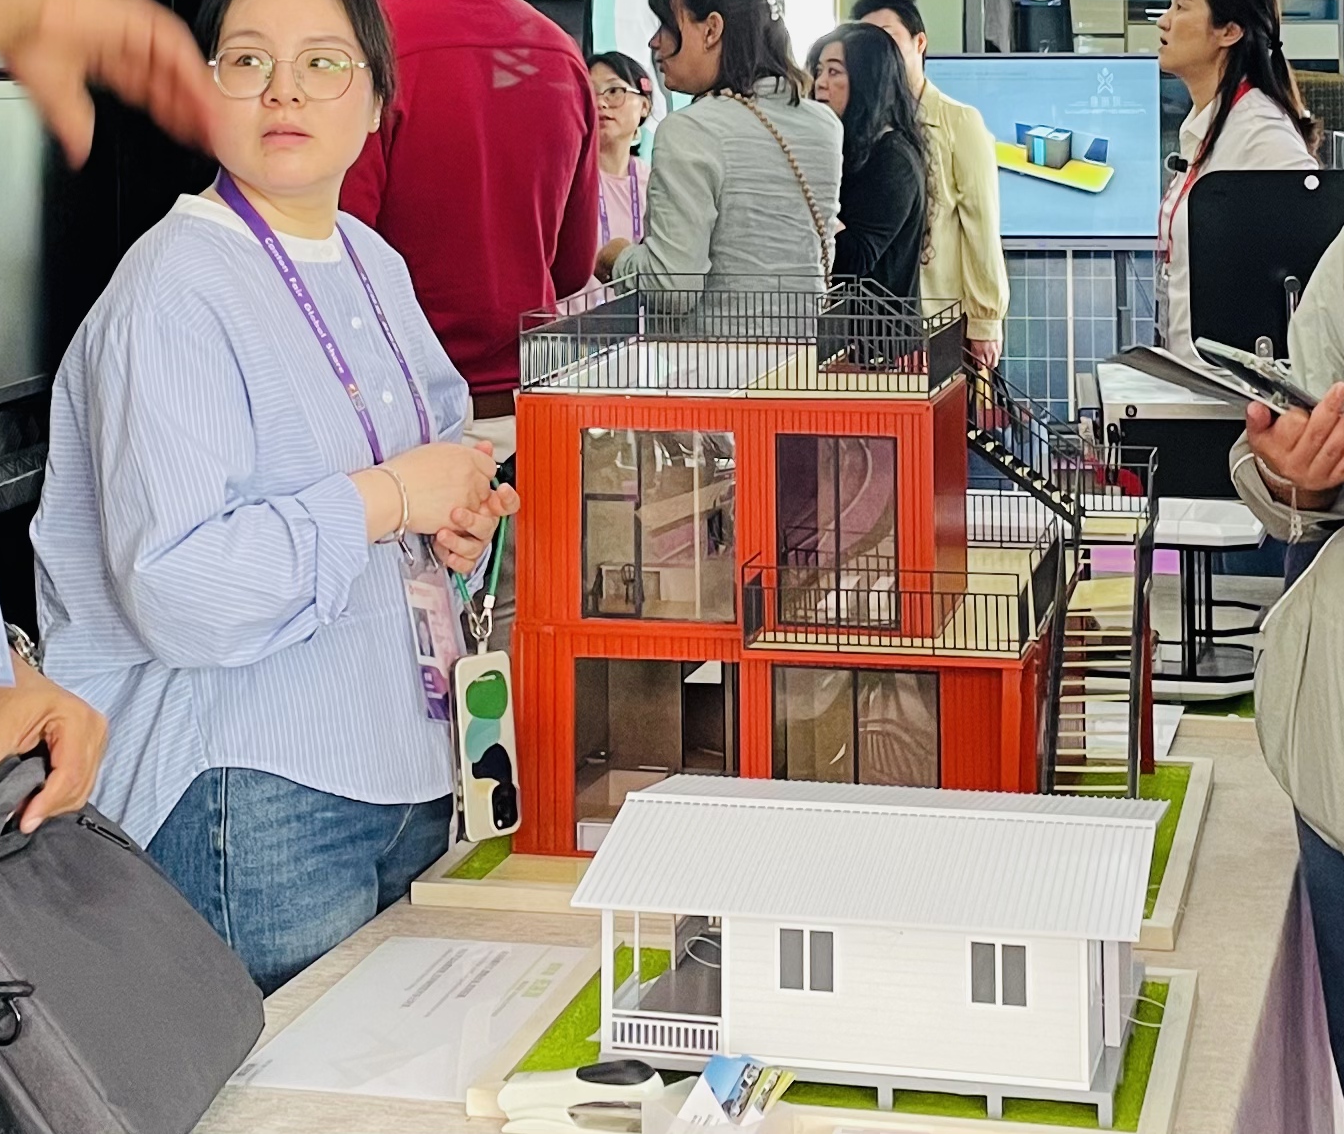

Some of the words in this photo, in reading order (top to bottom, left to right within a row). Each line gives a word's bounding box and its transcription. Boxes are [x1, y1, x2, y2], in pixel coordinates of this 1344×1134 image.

[265, 237, 289, 273] Canton
[289, 277, 303, 298] Fair
[304, 302, 327, 338] Global
[326, 342, 345, 374] Share
